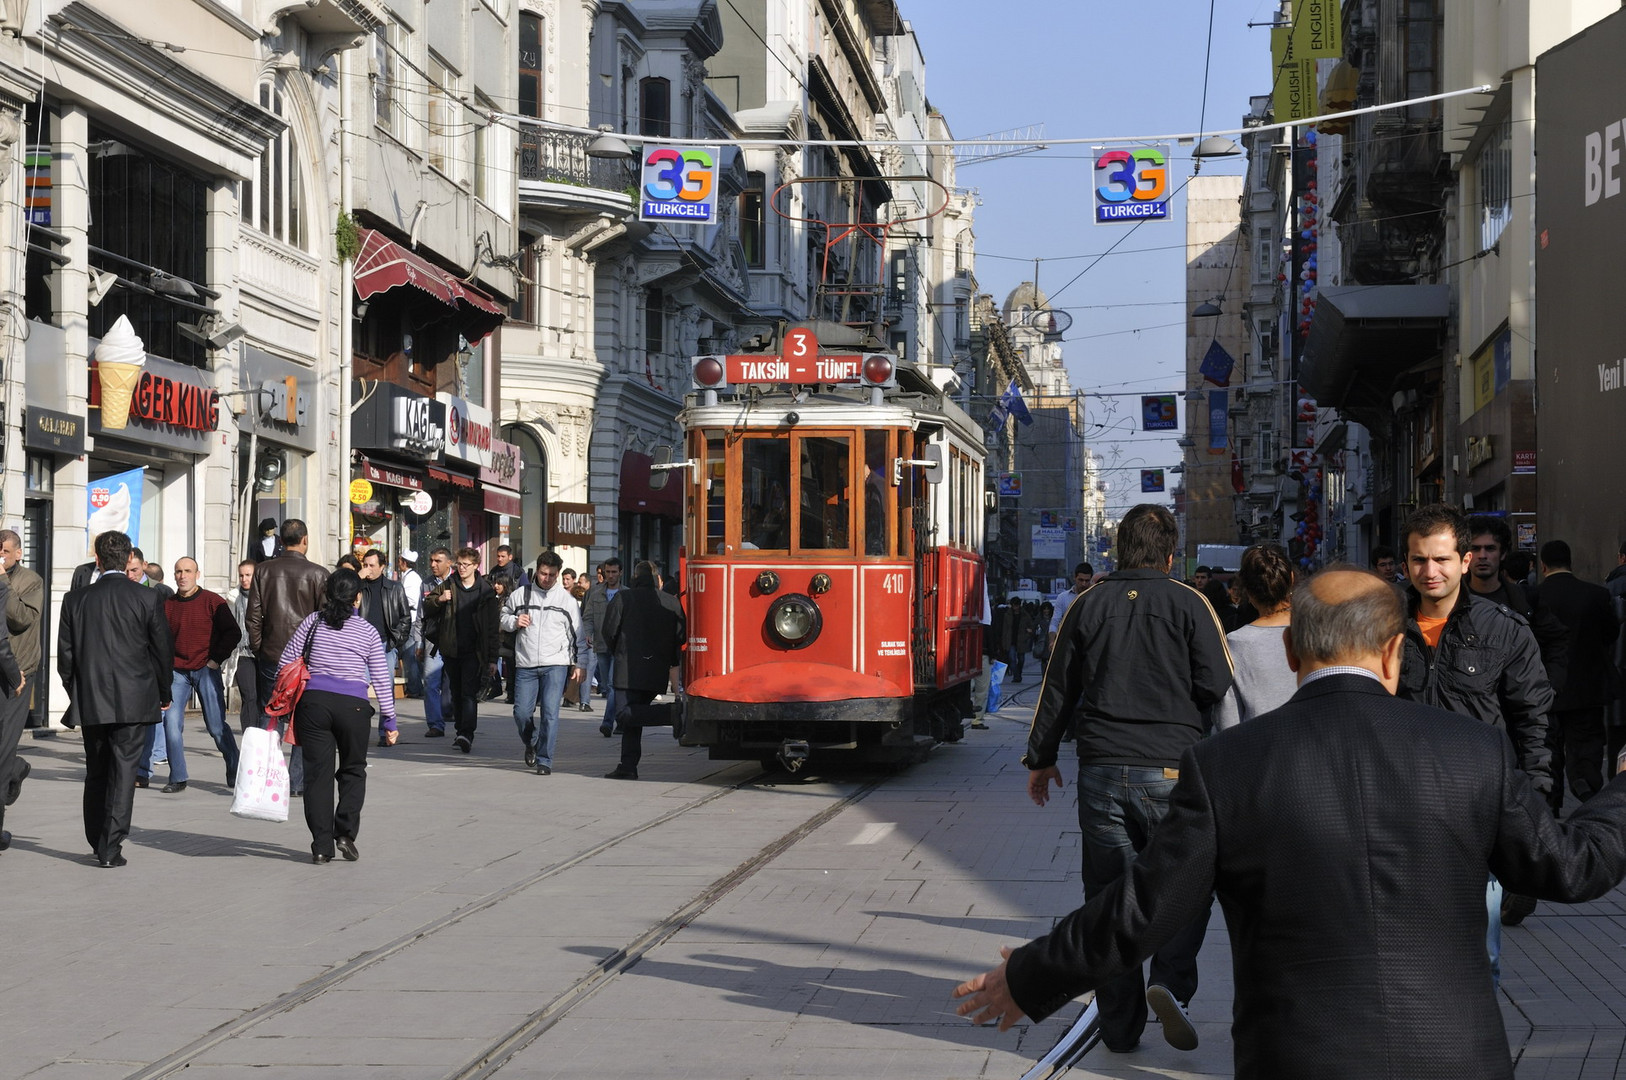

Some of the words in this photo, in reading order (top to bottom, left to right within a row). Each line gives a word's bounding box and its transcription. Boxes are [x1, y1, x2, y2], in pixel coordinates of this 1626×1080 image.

[1290, 70, 1301, 118] ENGLISH
[647, 149, 713, 201] 3G
[1097, 149, 1165, 202] 3G
[1585, 118, 1626, 207] BE
[647, 203, 708, 216] TURKCELL
[1101, 203, 1164, 217] TURKCELL
[793, 334, 808, 357] 3
[741, 358, 790, 380] TAKSİM
[816, 358, 861, 380] TÜNEL
[1598, 360, 1620, 392] Yeni
[178, 382, 220, 432] KING
[883, 573, 904, 594] 410
